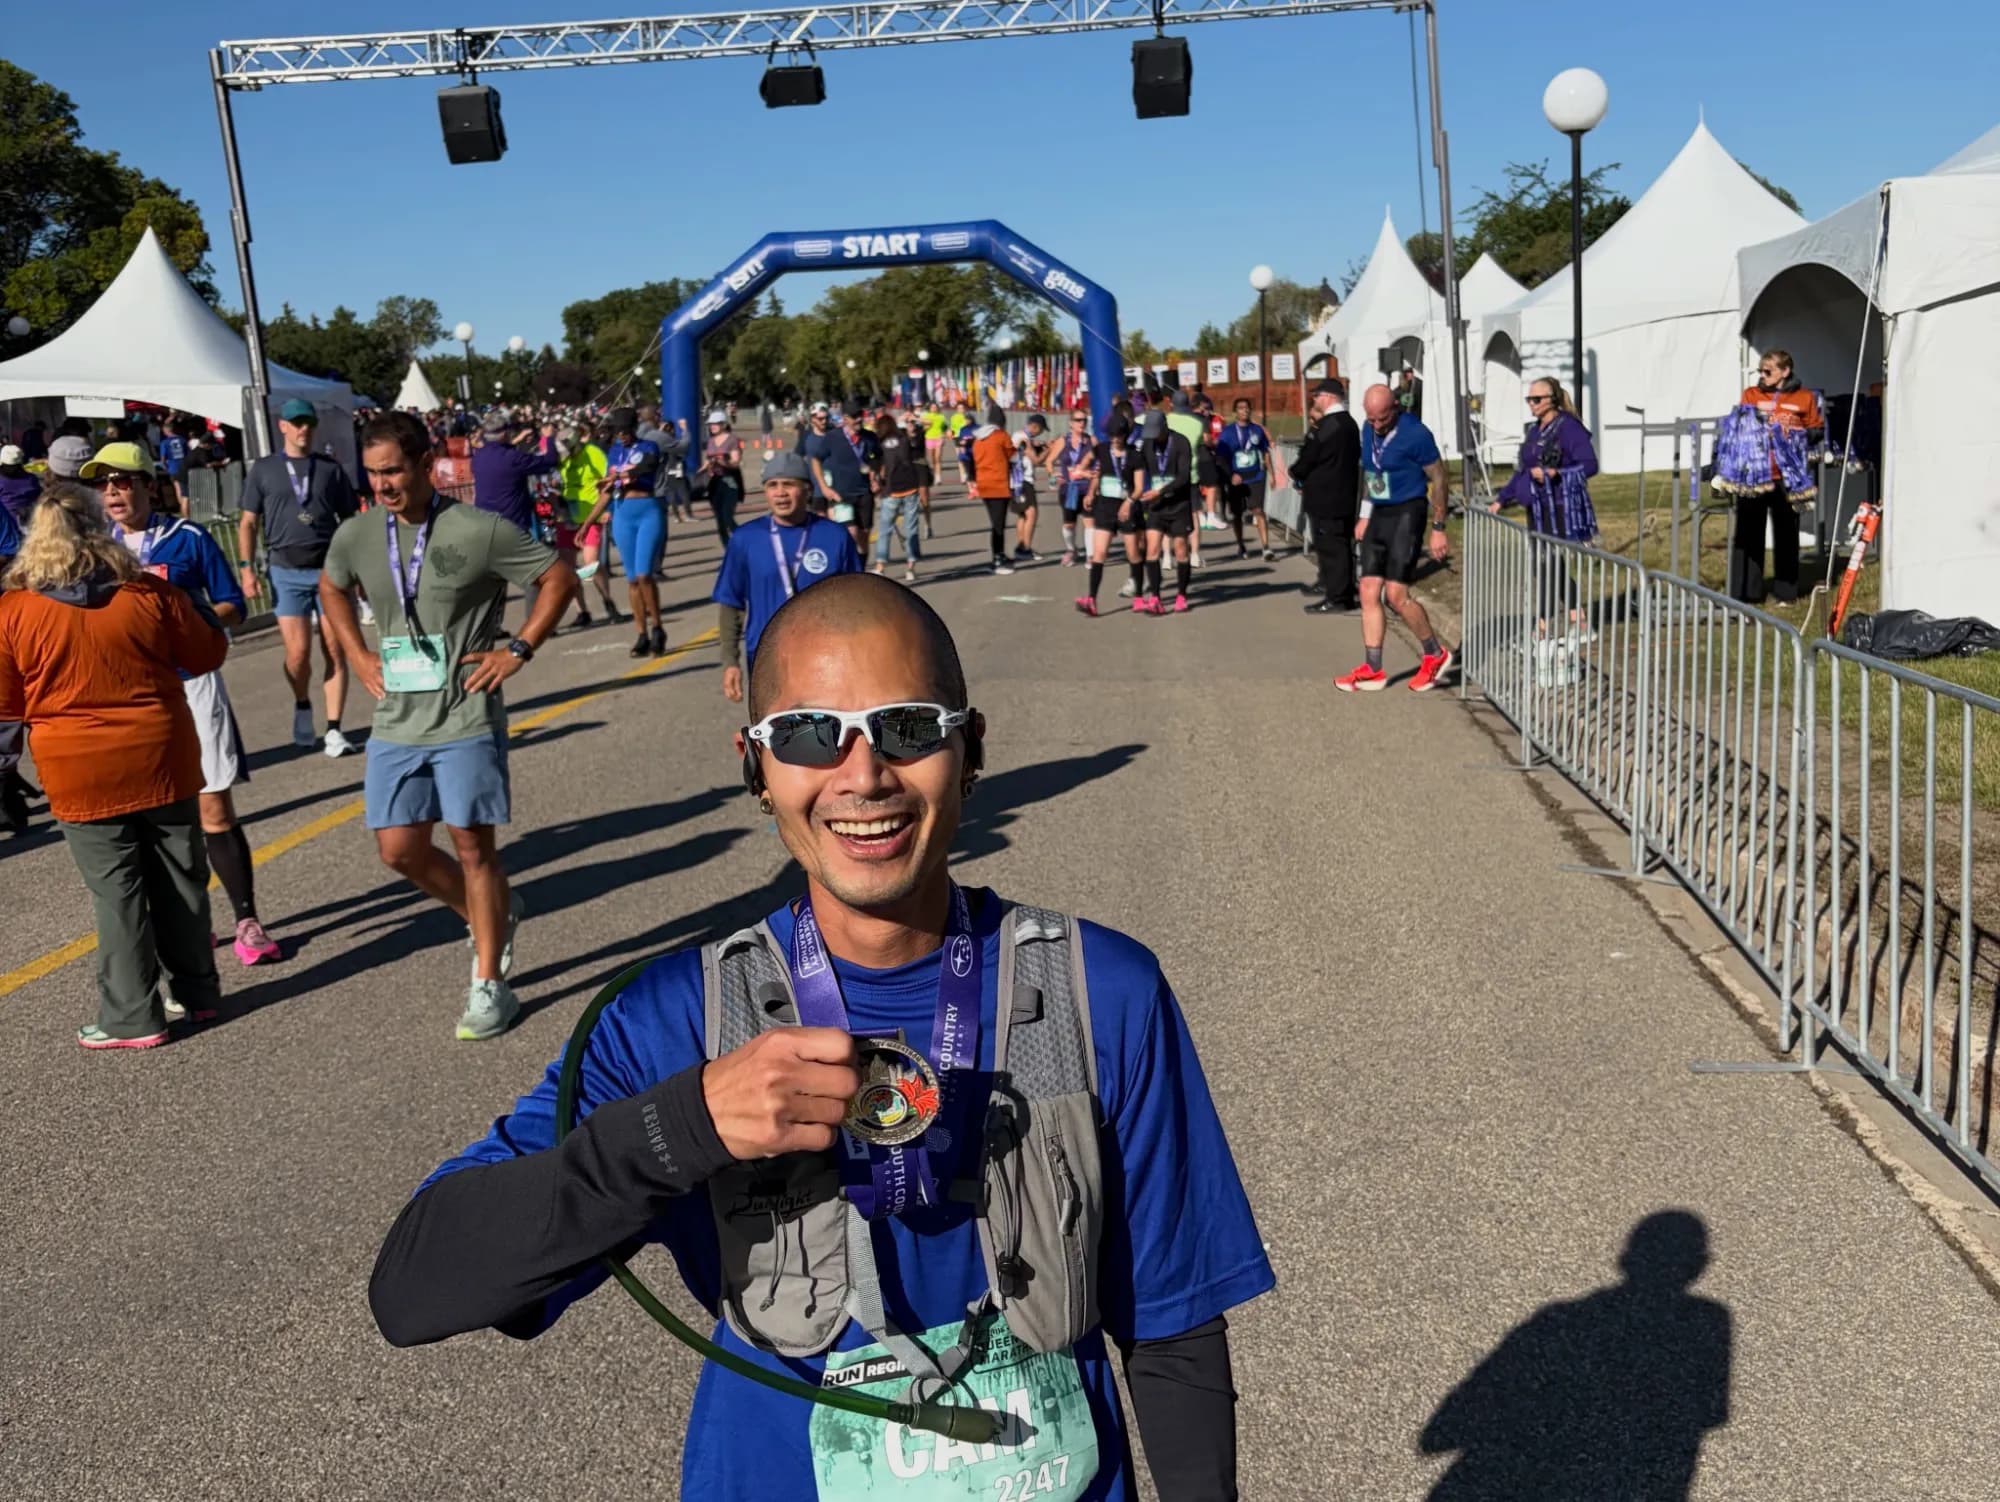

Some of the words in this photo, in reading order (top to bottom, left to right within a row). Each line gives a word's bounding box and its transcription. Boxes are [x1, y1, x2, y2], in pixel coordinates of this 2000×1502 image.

[842, 232, 921, 258] START
[798, 920, 813, 970] MARATHON
[939, 1003, 959, 1071] COUNTRY
[890, 1145, 906, 1187] OUTH
[988, 1334, 1020, 1351] UEEN
[823, 1366, 861, 1387] RUN
[866, 1360, 906, 1378] REGI
[993, 1452, 1070, 1502] 2247
